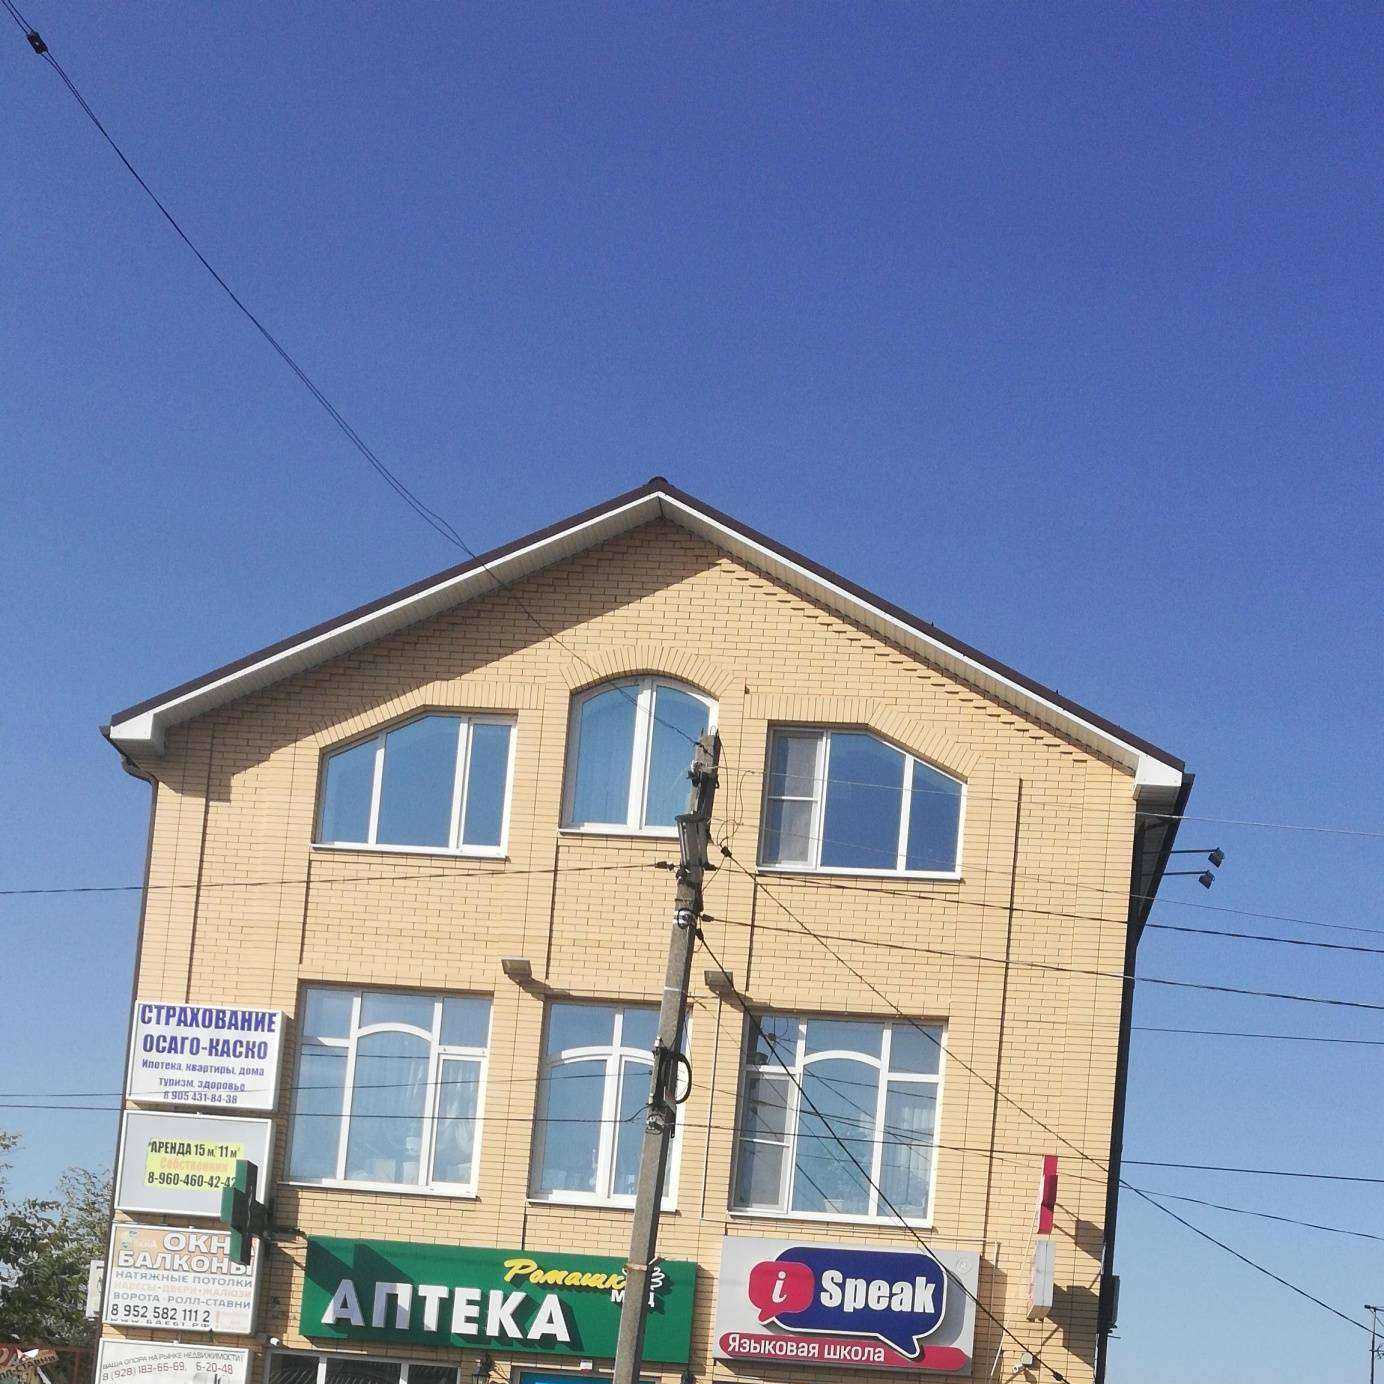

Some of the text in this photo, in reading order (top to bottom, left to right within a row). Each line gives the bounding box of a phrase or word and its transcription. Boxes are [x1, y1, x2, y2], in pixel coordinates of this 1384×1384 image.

[140, 1003, 277, 1033] СТРАХОВАНИЕ
[142, 1034, 269, 1060] ОСАГО-КАСКО
[171, 1091, 190, 1101] 905
[150, 1141, 192, 1157] АРЕНДА
[194, 1143, 206, 1156] 15
[219, 1145, 229, 1158] 11
[117, 1249, 253, 1277] БАЛКОНЫ
[115, 1271, 253, 1288] НАТЯЖНЫЕ ПОТОЛКИ
[771, 1268, 936, 1314] i Speak
[110, 1303, 119, 1316] 8
[123, 1304, 148, 1318] 952
[152, 1307, 178, 1321] 582
[113, 1291, 251, 1310] ВОРОТА РОЛЛ-СТАВНИ
[320, 1278, 571, 1343] АПТЕКА
[727, 1333, 885, 1362] Языковая школа
